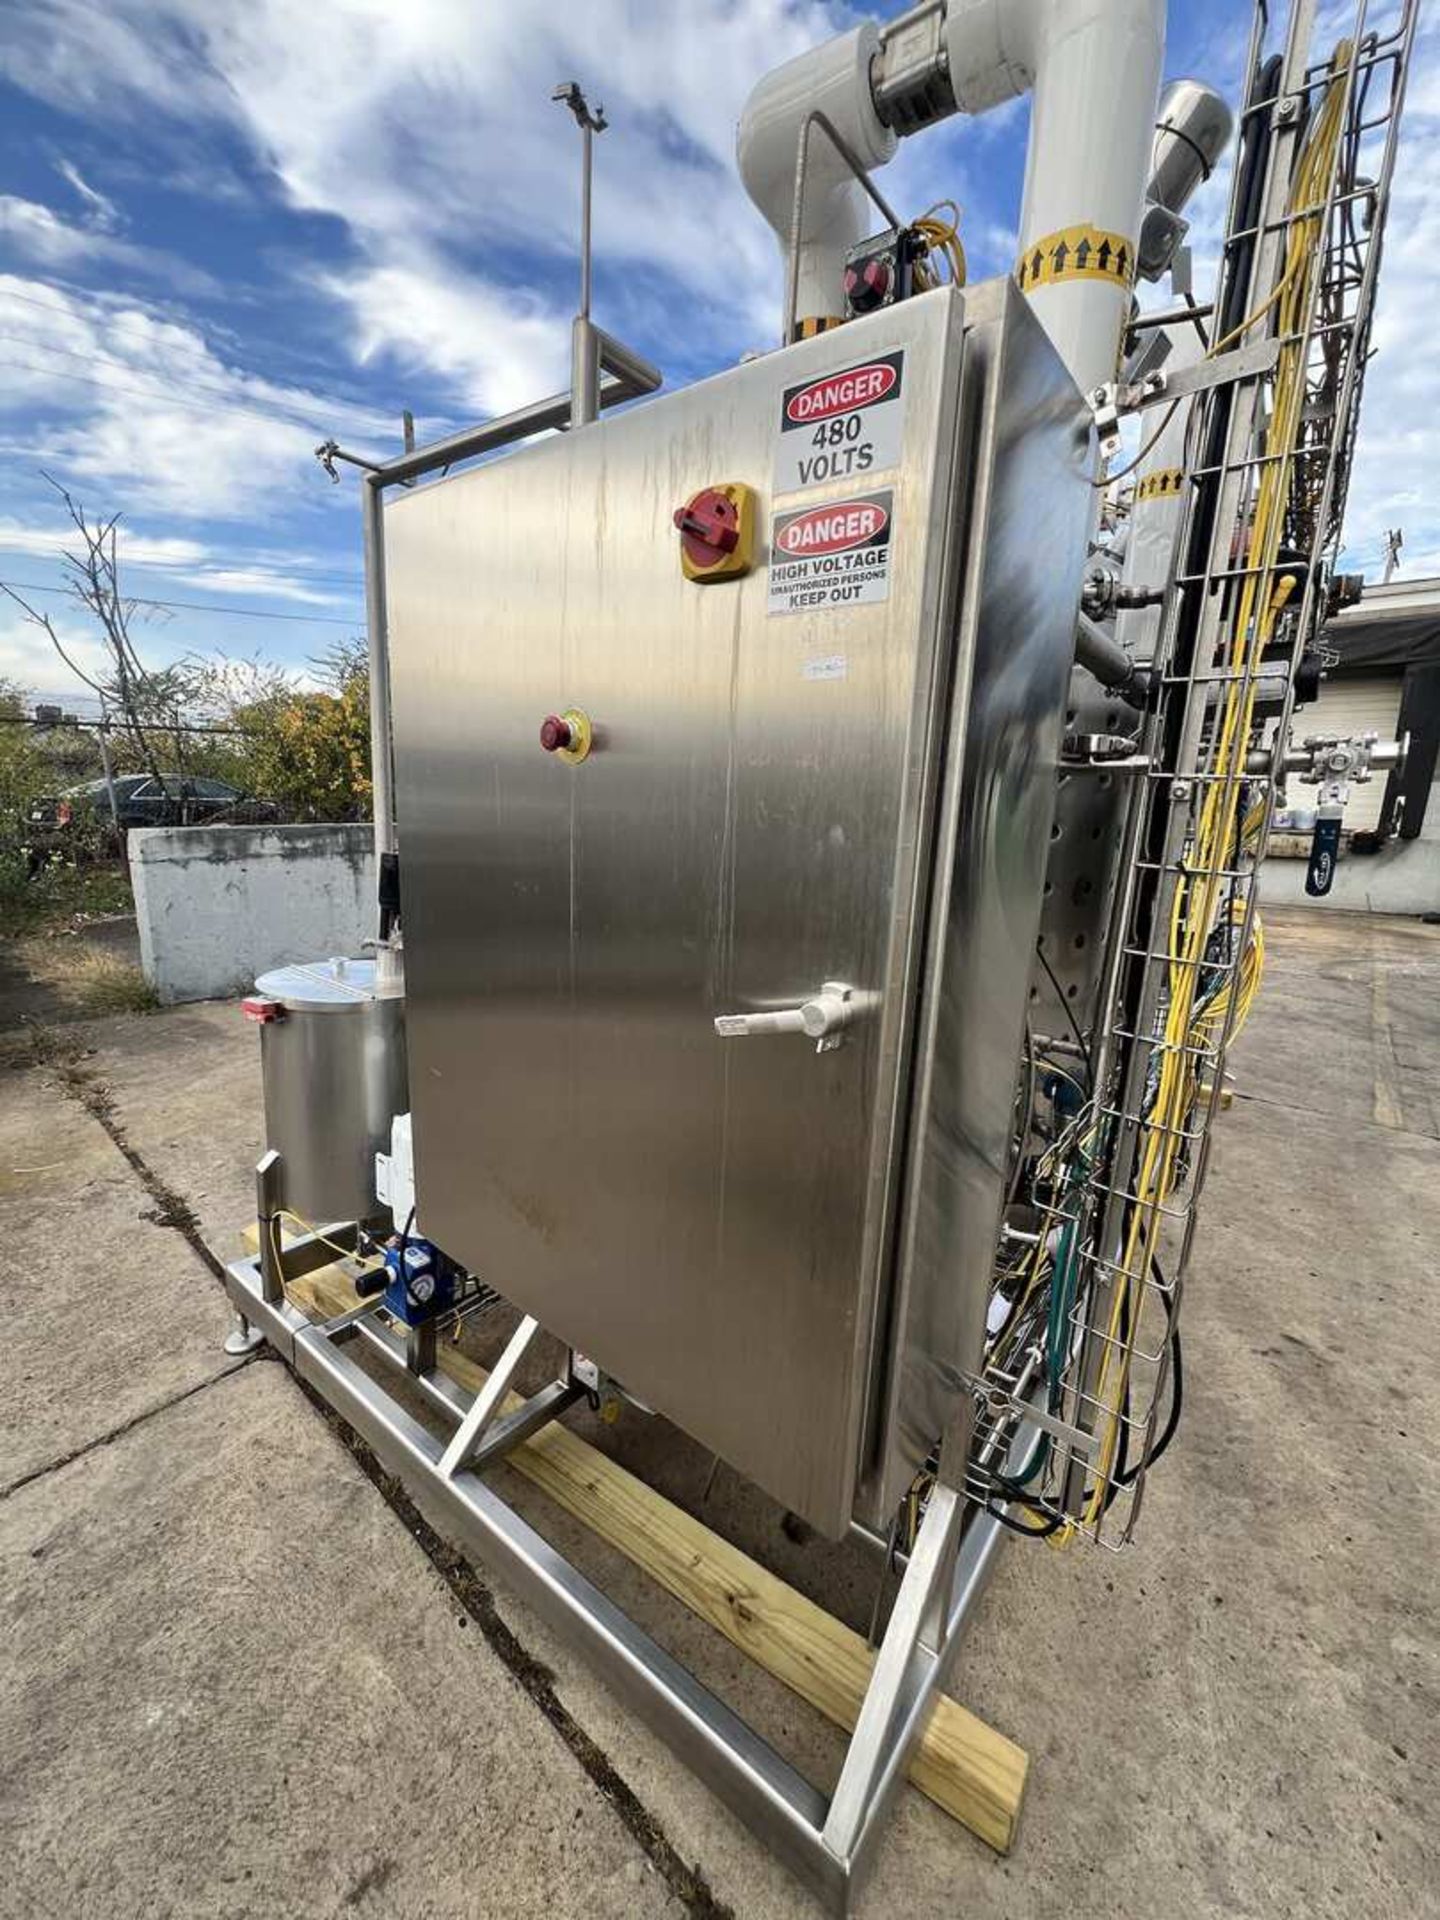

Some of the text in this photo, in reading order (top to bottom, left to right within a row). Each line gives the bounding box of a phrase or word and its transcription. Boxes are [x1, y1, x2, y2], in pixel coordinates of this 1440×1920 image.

[798, 370, 884, 417] DANGER
[812, 414, 862, 449] 480
[798, 443, 874, 484] VOLTS
[787, 509, 876, 549] DANGER
[771, 549, 888, 582] HIGH VOLTAGE
[771, 568, 887, 595] UNAUTHORIZED PERSONS
[789, 585, 863, 608] KEEP OUT
